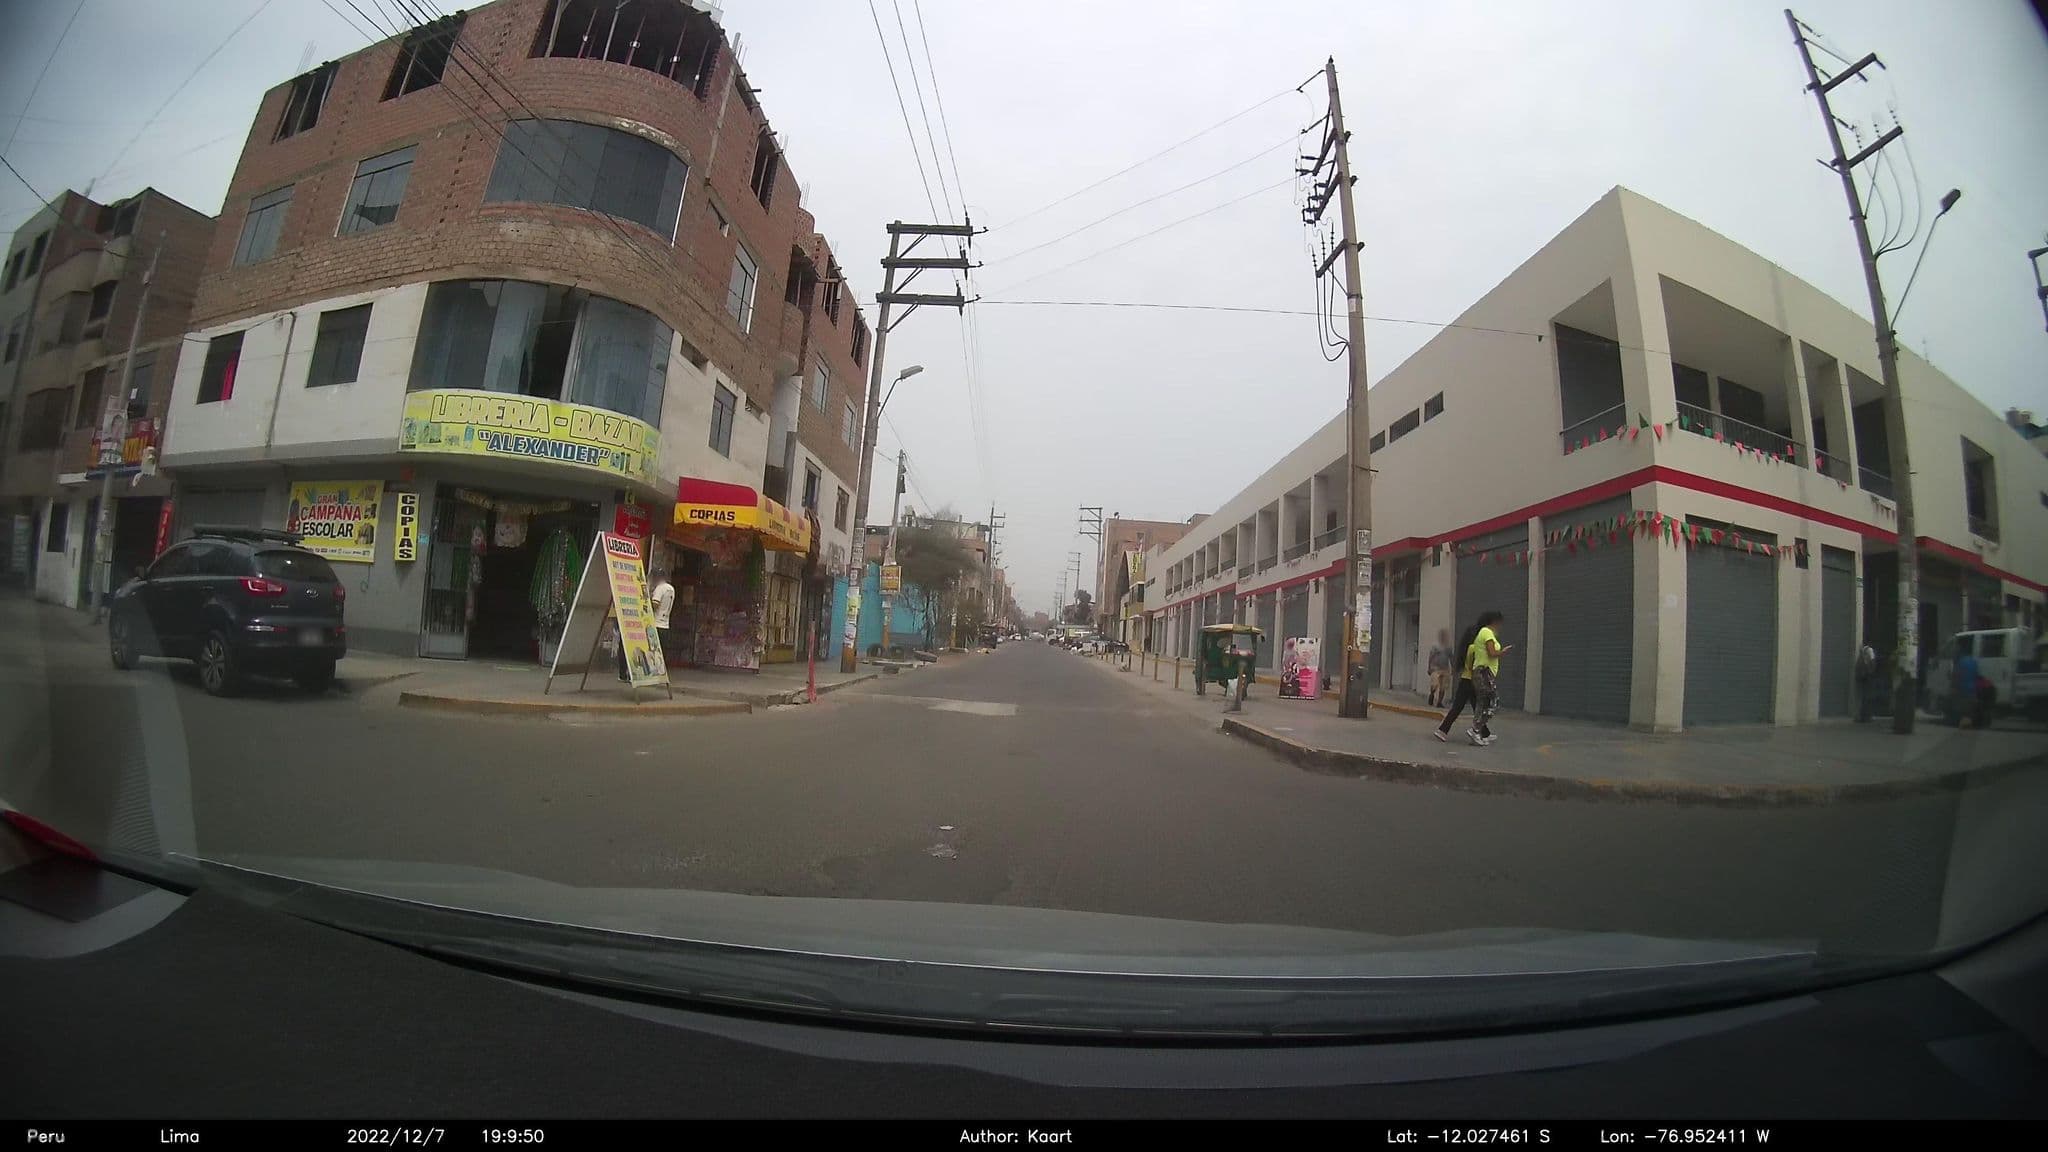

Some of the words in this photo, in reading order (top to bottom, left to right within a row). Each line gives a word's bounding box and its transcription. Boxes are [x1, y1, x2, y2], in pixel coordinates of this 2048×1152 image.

[430, 394, 550, 433] LIBRERIA
[570, 408, 644, 451] BAZAR
[477, 430, 611, 467] "ALEXANDER"
[317, 495, 338, 505] GRAN
[300, 502, 362, 521] CAMPAÑA
[689, 508, 736, 521] COPIAS
[302, 521, 354, 539] ESCOLAR
[398, 494, 416, 559] COPIAS
[607, 537, 640, 557] LIBRERIA
